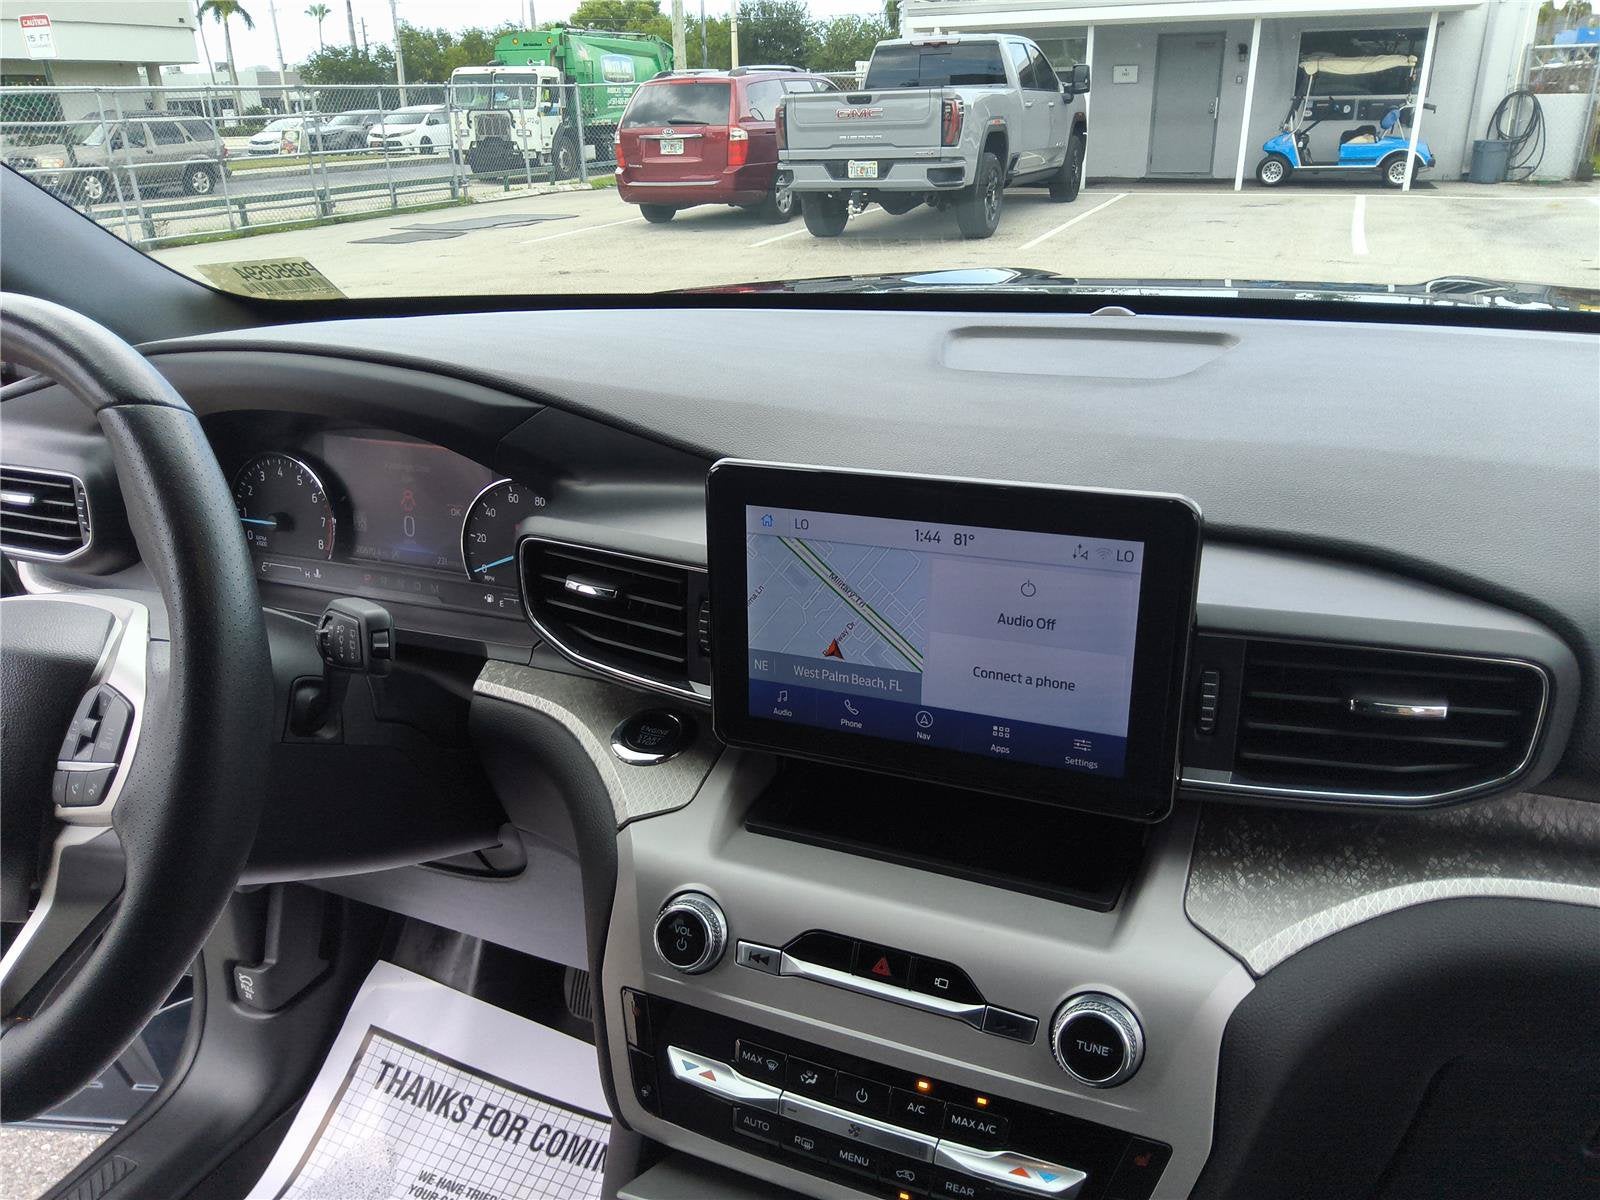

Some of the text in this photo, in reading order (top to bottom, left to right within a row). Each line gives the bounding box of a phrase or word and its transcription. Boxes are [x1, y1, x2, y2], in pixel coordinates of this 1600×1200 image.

[22, 18, 48, 27] CAUTION
[836, 107, 884, 120] GMC
[259, 471, 265, 482] 3
[296, 475, 303, 486] 5
[311, 493, 318, 504] 6
[508, 493, 519, 504] 60
[534, 496, 546, 507] 80
[485, 508, 496, 518] 40
[320, 516, 326, 528] 7
[403, 515, 416, 537] 0
[794, 518, 809, 530] LO
[247, 529, 254, 541] 0
[476, 533, 487, 543] 20
[914, 529, 942, 544] 1:44
[318, 539, 325, 550] 8
[1116, 550, 1135, 563] LO
[997, 613, 1057, 631] Audio Off
[754, 659, 769, 671] NE
[793, 665, 903, 692] West Palm Beach, FL
[972, 666, 1076, 692] Connect a phone
[773, 707, 793, 718] Audio
[840, 718, 863, 729] Phone
[916, 730, 932, 741] Nav
[990, 743, 1010, 755] Apps
[1064, 756, 1098, 770] Settings
[674, 924, 692, 937] VOL
[1076, 1039, 1110, 1057] TUNE
[741, 1050, 763, 1065] MAX
[907, 1101, 926, 1116] A/C
[373, 1059, 609, 1175] THANKS FOR COMIN
[743, 1116, 770, 1131] AUTO
[951, 1113, 997, 1136] MAX A/C
[838, 1149, 870, 1167] MENU
[418, 1169, 438, 1186] WE
[435, 1176, 467, 1195] HAVE
[408, 1183, 439, 1200] YOUR
[944, 1180, 976, 1198] REAR
